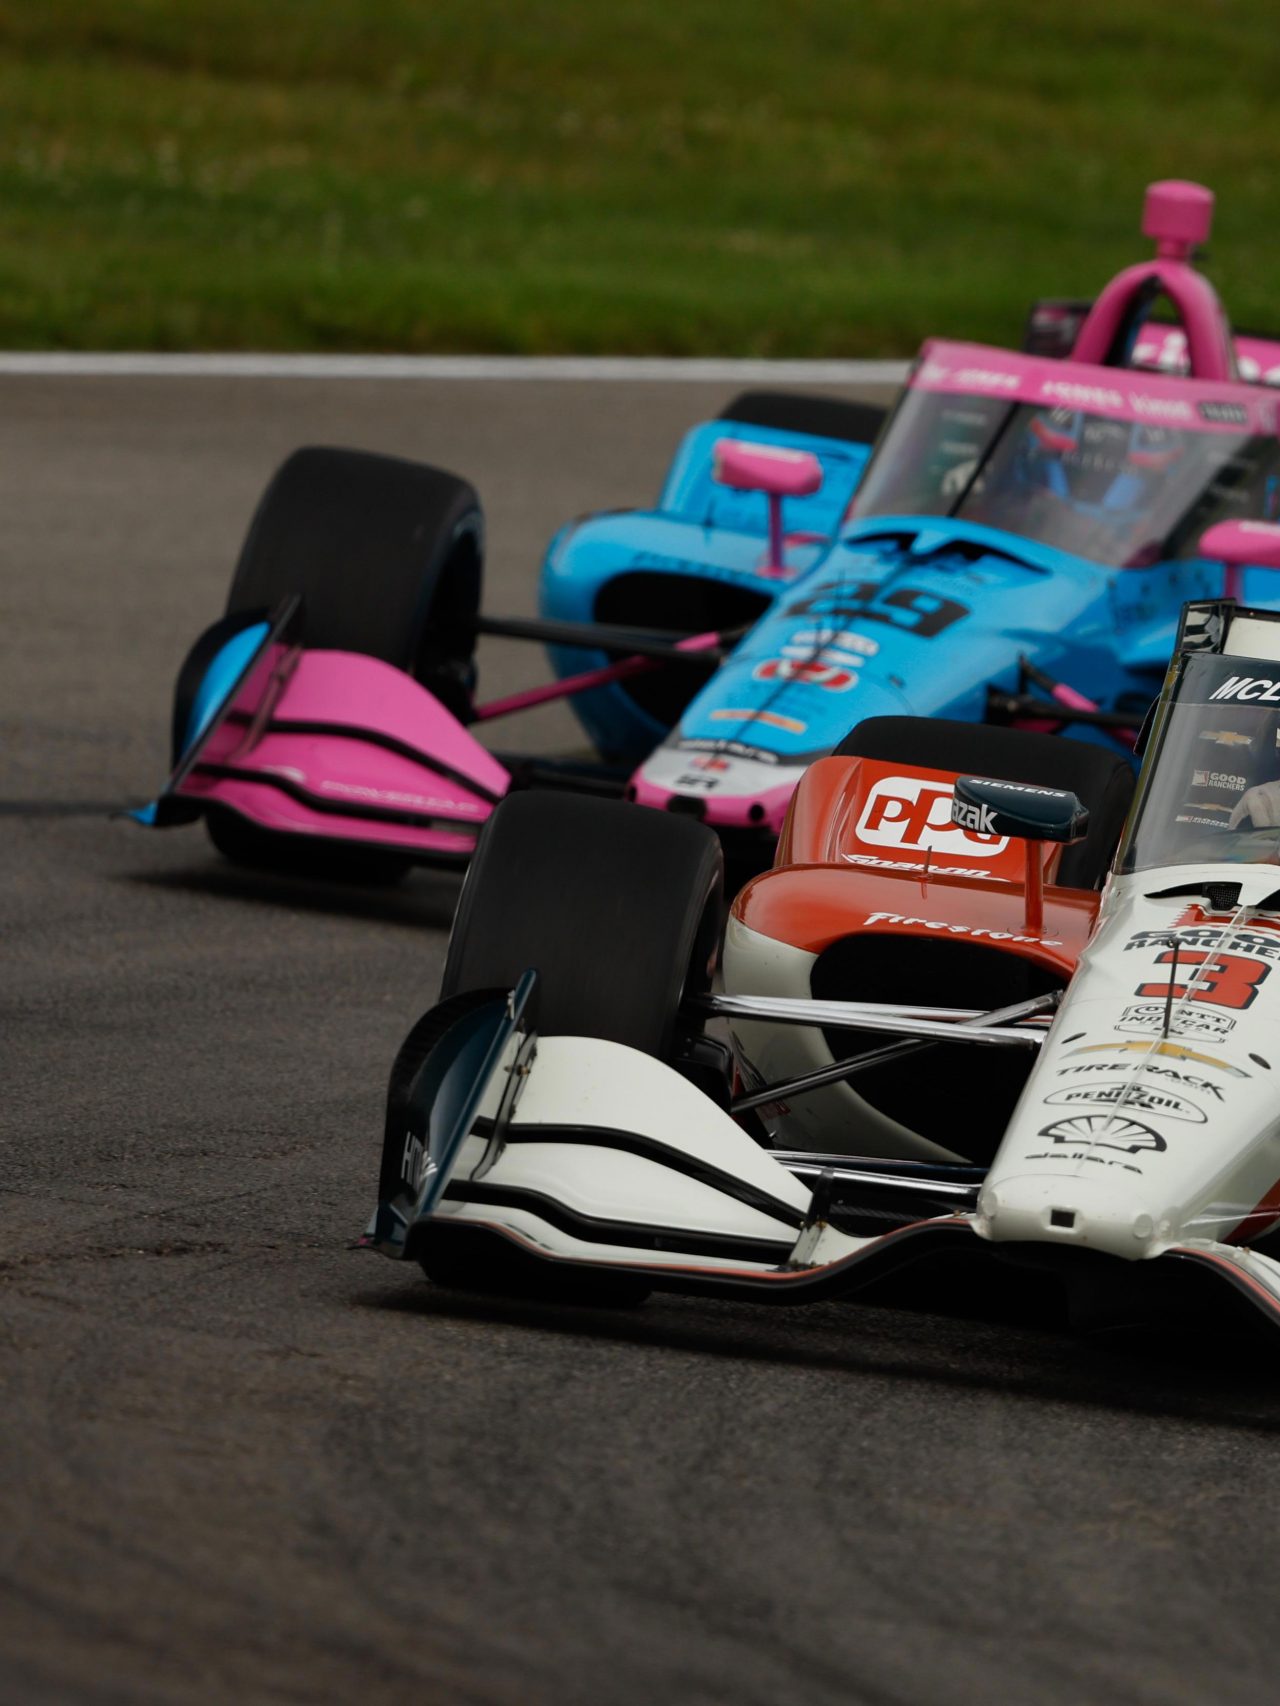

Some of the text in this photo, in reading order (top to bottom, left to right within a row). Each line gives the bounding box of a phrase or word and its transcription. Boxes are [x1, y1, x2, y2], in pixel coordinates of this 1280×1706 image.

[969, 778, 1067, 798] SIEMENS
[1210, 772, 1247, 785] GOOD
[951, 804, 998, 834] azak
[863, 911, 1063, 946] Firestone
[1134, 949, 1273, 1010] 3
[1056, 1063, 1132, 1076] TIRE
[1132, 1063, 1226, 1102] RACK
[1064, 1089, 1183, 1112] PENNZOIL
[1024, 1151, 1144, 1175] dallara
